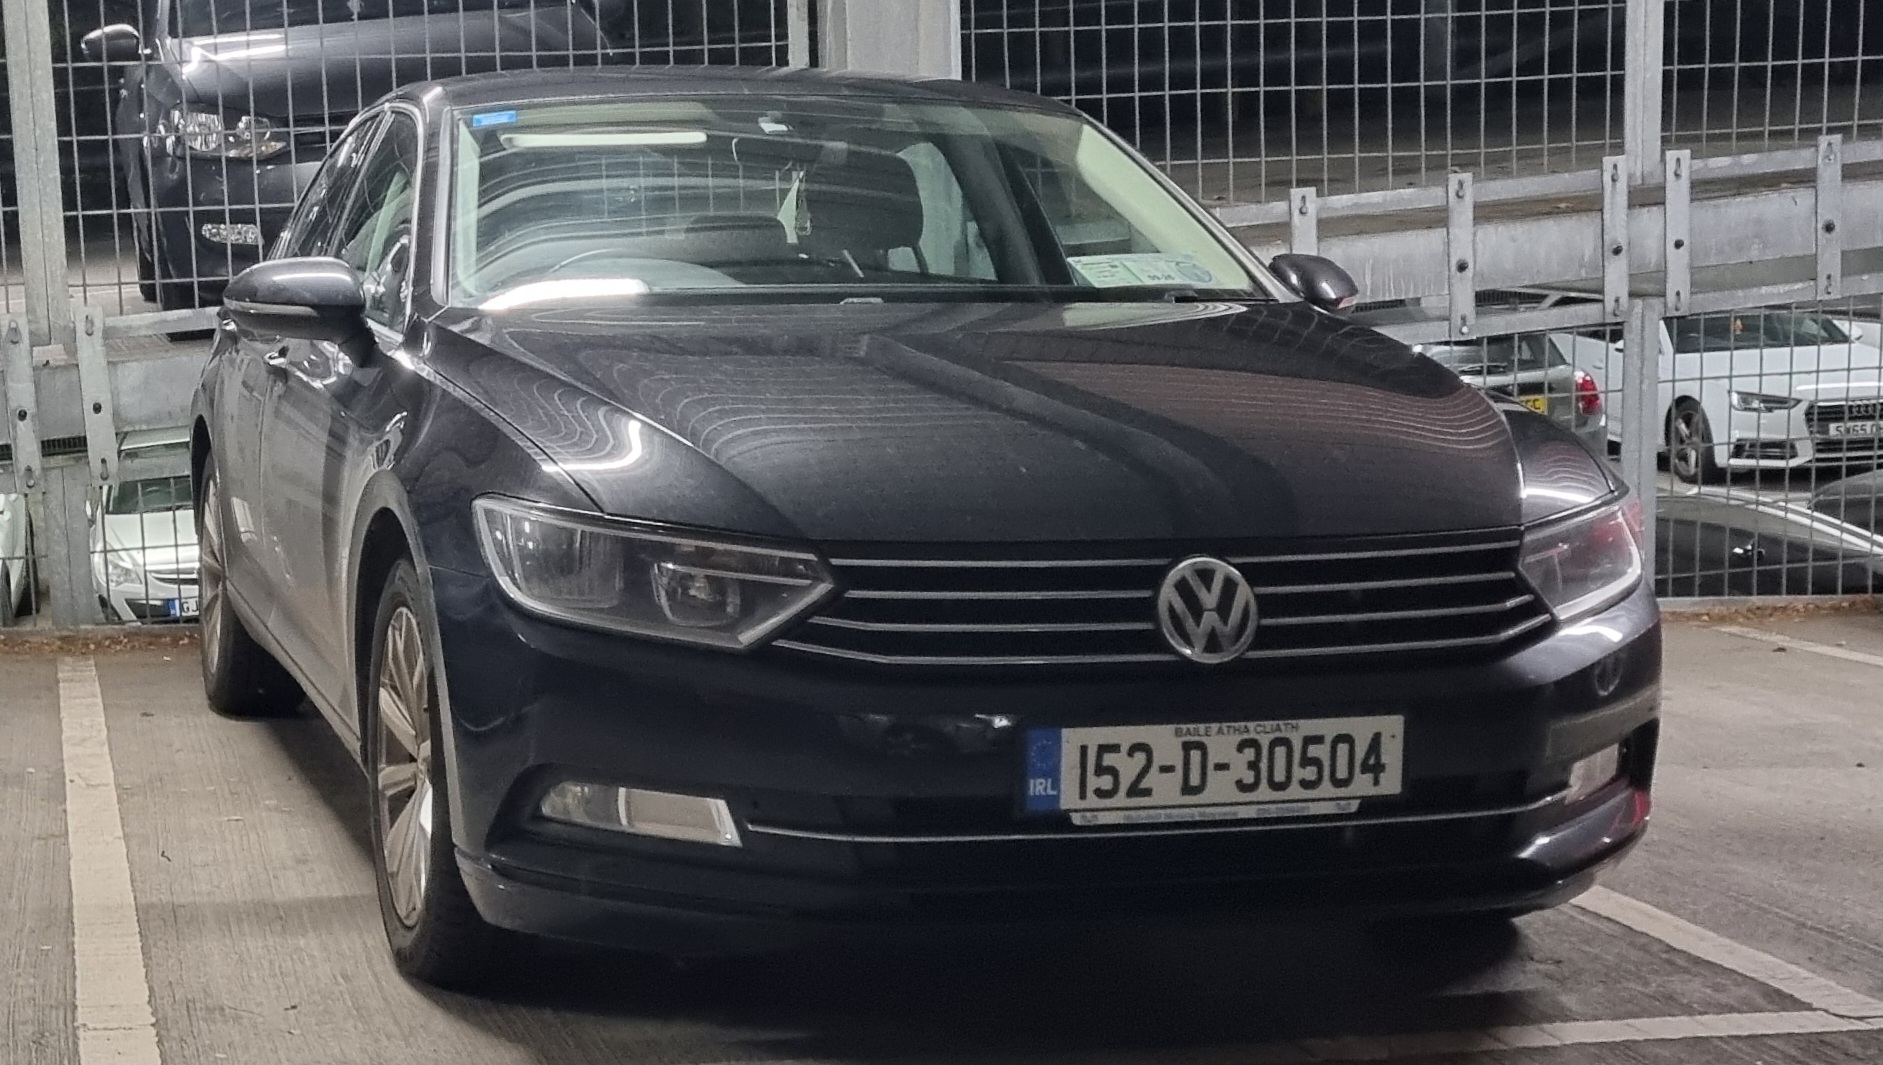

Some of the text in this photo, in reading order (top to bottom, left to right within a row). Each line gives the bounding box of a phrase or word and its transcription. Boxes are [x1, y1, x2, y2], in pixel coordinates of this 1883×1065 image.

[1174, 726, 1211, 737] BAILE
[1254, 722, 1299, 734] CLIATH
[1078, 731, 1385, 800] 152-D-30504
[1030, 778, 1057, 796] IRL
